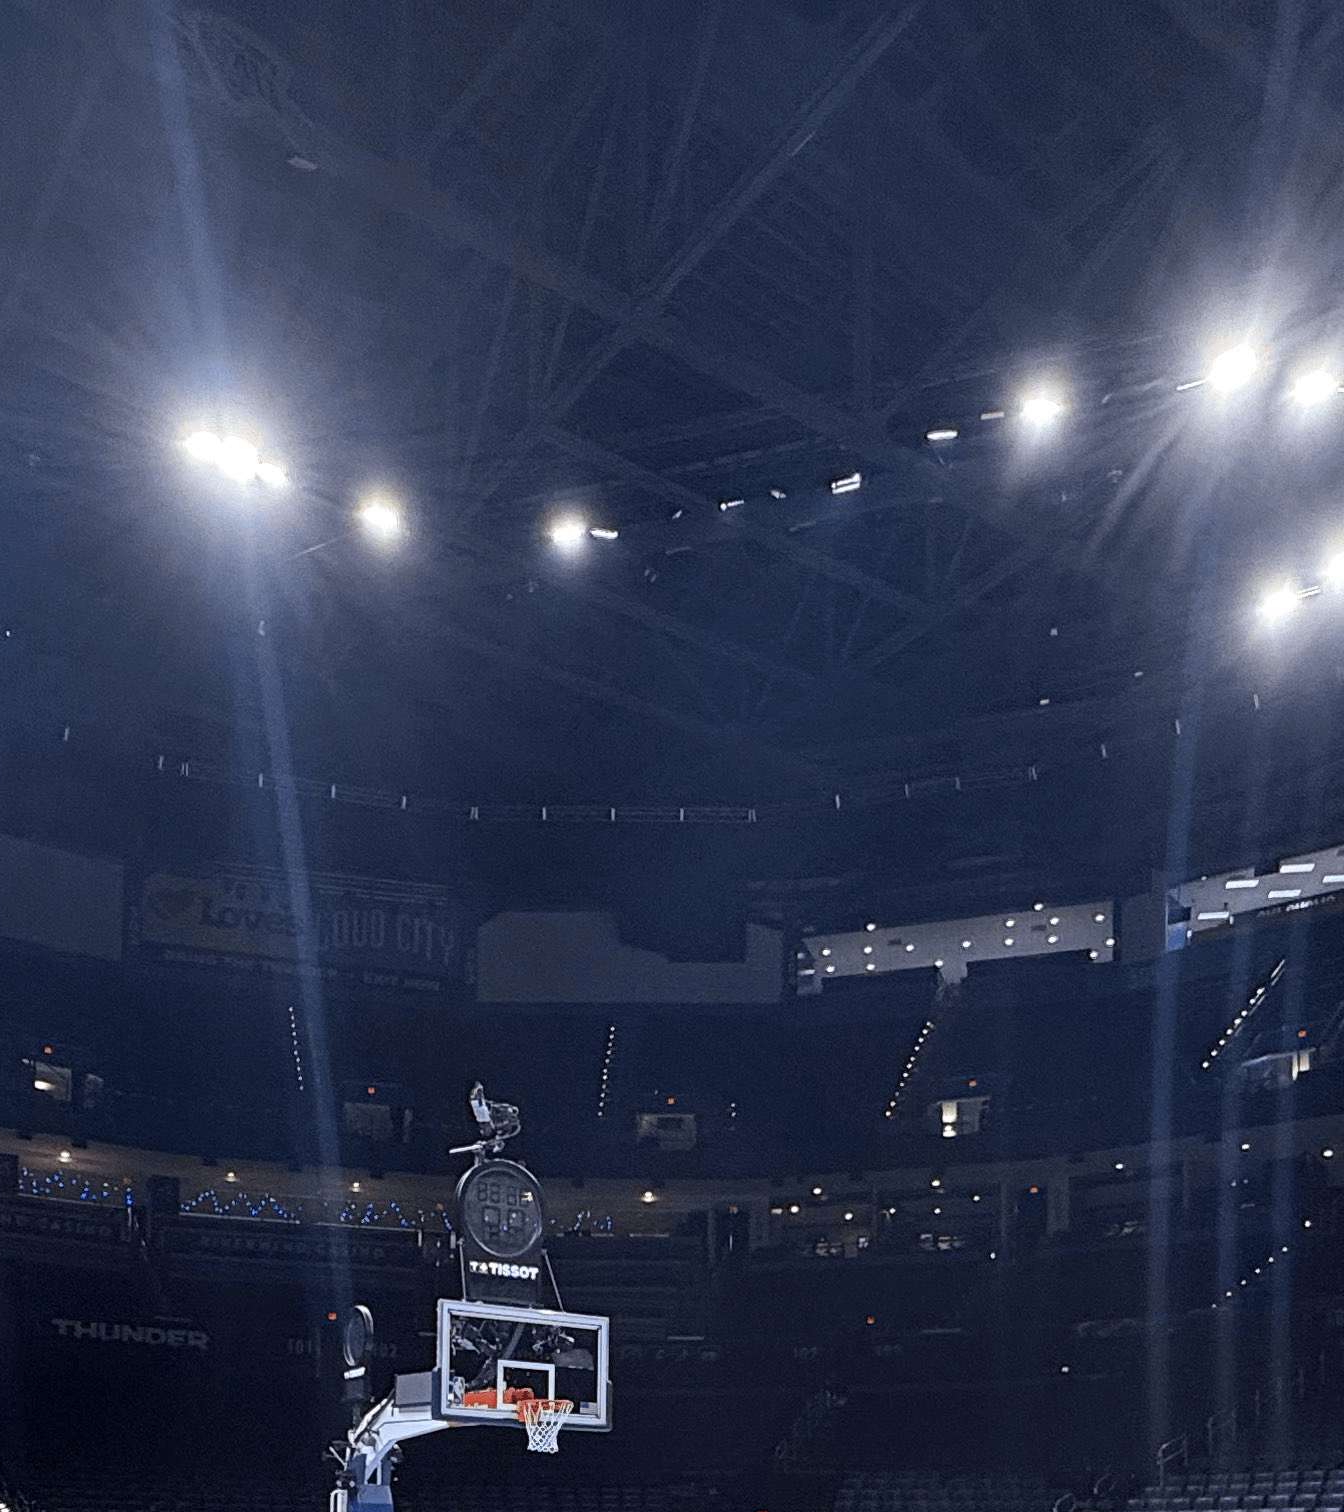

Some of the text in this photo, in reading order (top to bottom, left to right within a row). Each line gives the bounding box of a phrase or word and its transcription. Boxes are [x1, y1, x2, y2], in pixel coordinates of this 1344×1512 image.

[396, 912, 456, 967] CITY
[488, 1261, 540, 1281] TISSOT
[50, 1317, 211, 1351] THUNDER
